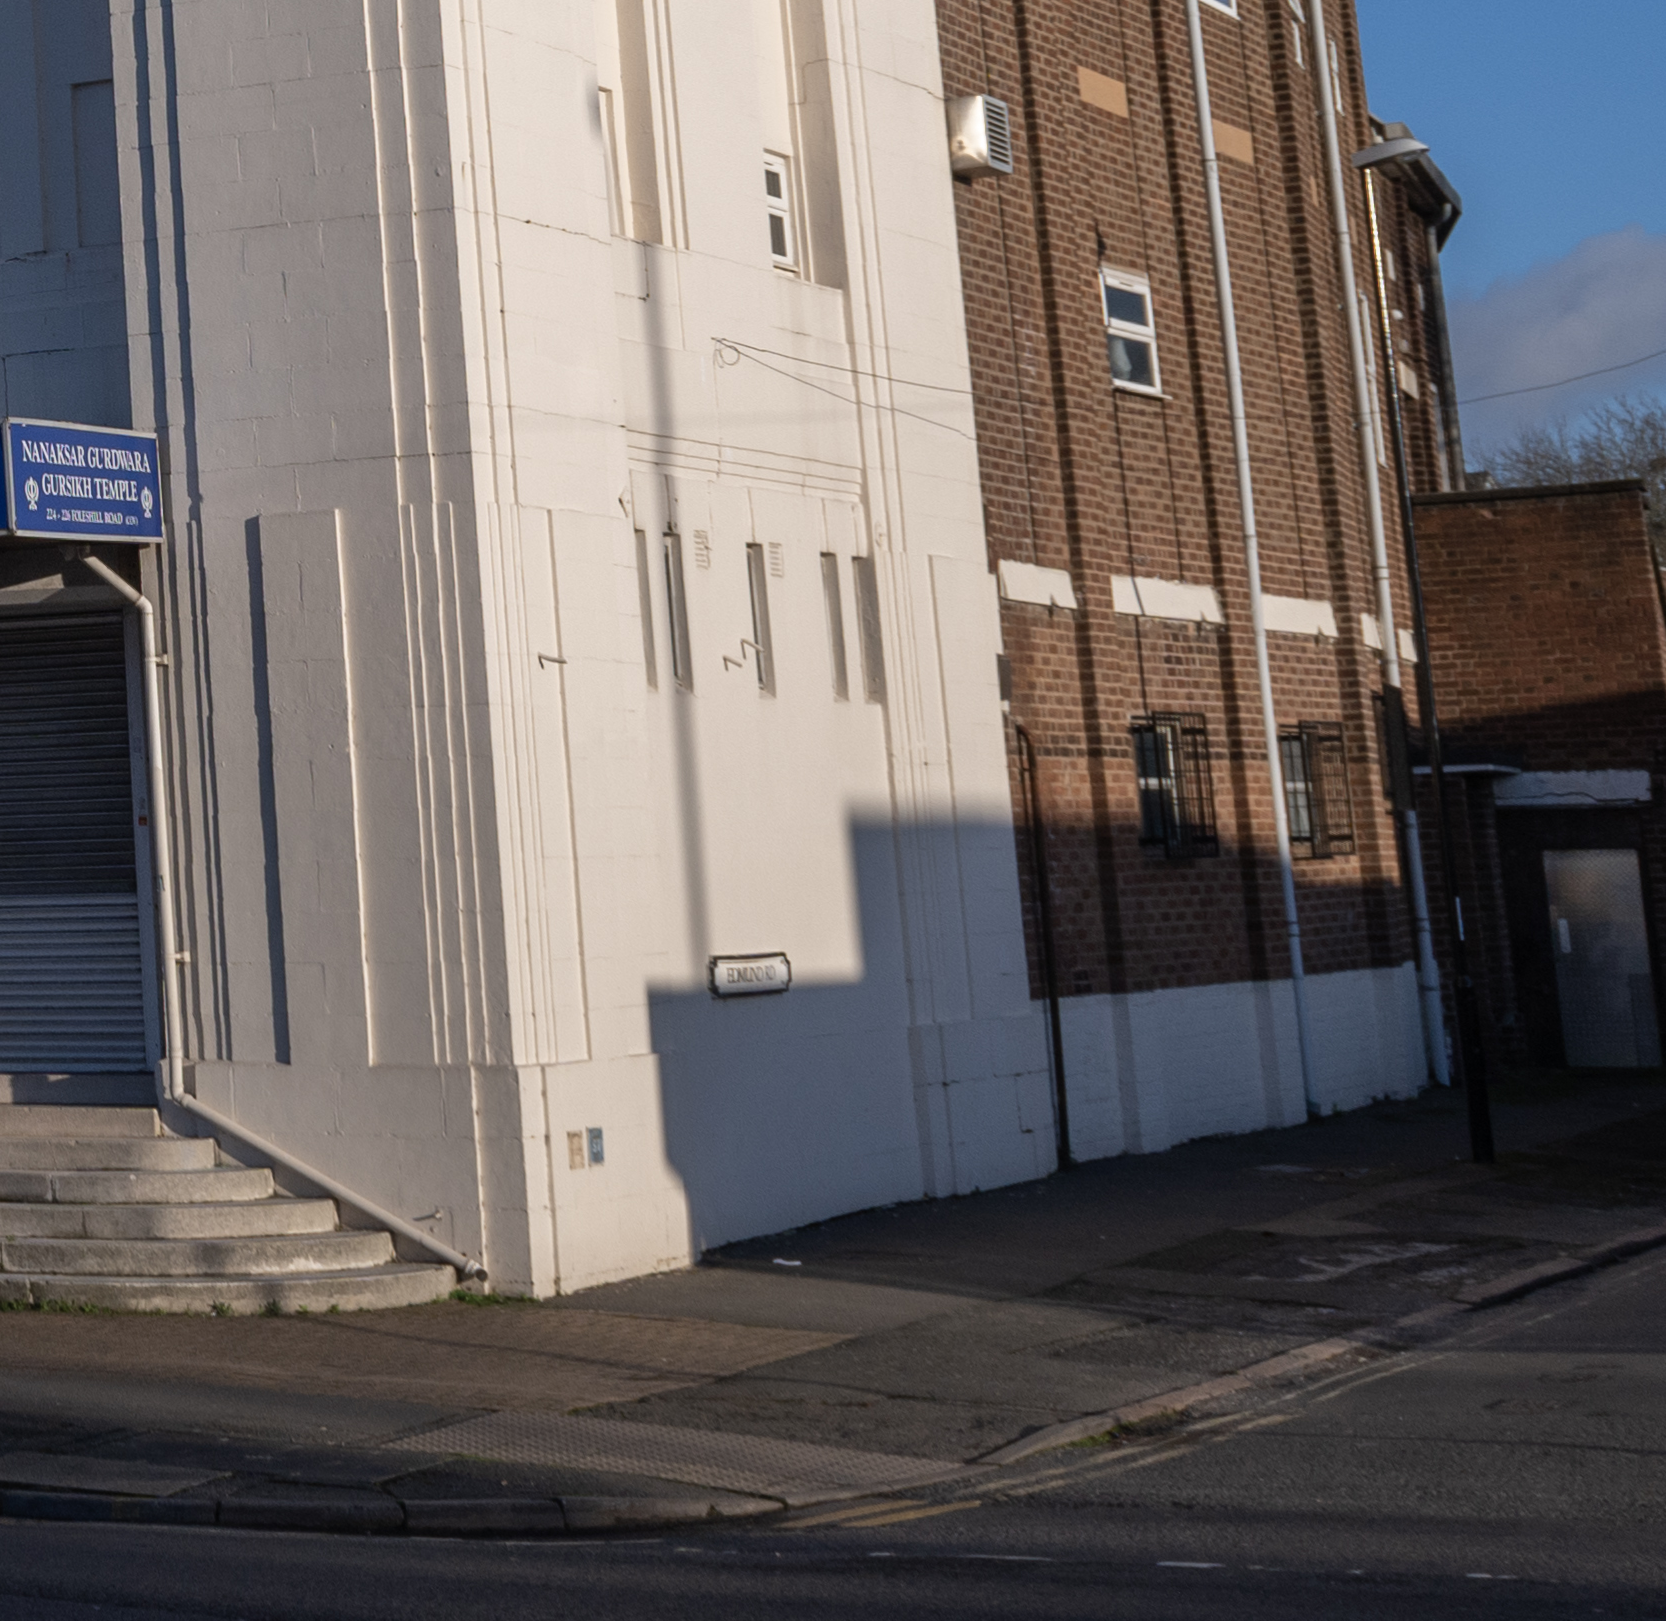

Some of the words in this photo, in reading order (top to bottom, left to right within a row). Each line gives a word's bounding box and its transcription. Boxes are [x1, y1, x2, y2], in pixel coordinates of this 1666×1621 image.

[22, 440, 86, 467] NANAKSAR
[87, 446, 151, 473] GURDWARA
[41, 473, 93, 499] GURSIKH
[94, 477, 139, 502] TEMPLE
[71, 510, 103, 523] FOLESHILL
[104, 512, 123, 524] ROAD
